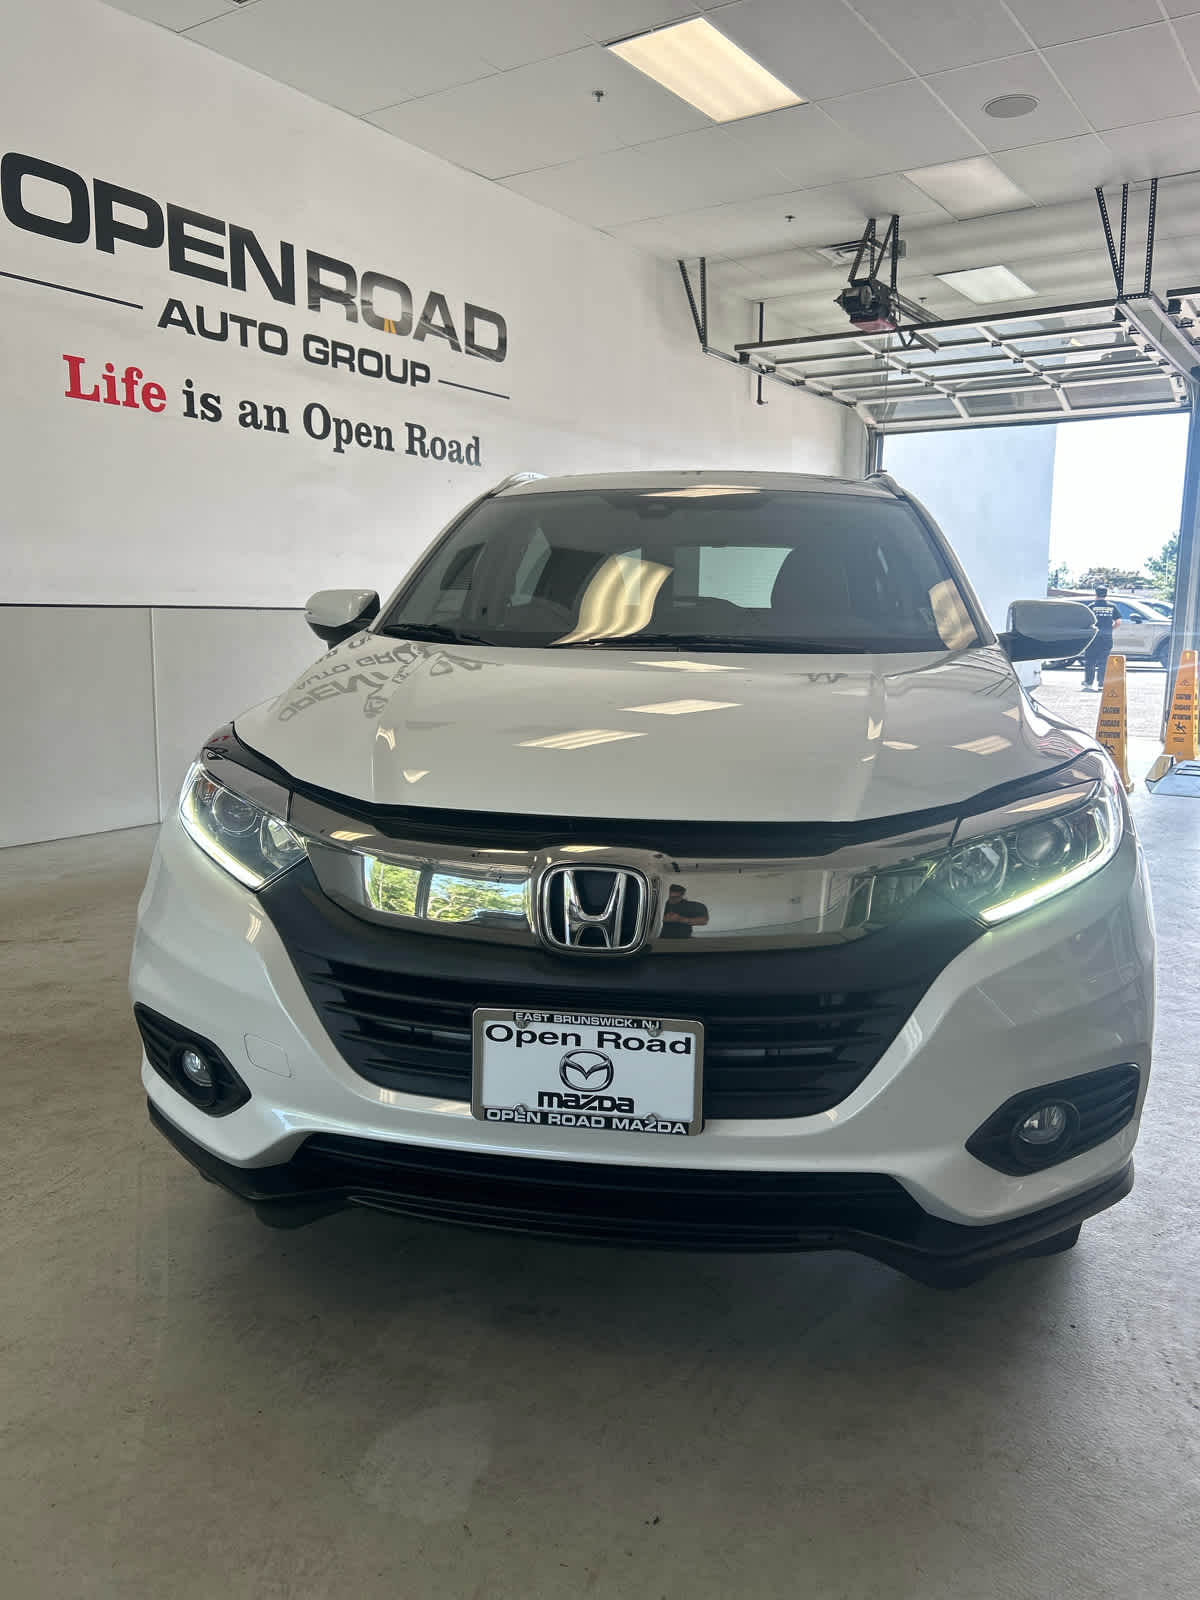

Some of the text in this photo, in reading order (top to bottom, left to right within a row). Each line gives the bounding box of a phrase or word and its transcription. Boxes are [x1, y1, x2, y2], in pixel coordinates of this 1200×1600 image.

[0, 152, 508, 363] OPEN ROAD
[157, 298, 431, 387] AUTO GROUP
[62, 354, 482, 467] Life is an Open Road
[515, 1012, 550, 1023] EAST
[642, 1020, 660, 1029] NJ
[485, 1024, 692, 1055] Open Road
[538, 1091, 634, 1114] mazda
[486, 1109, 687, 1134] OPEN ROAD MAZDA
